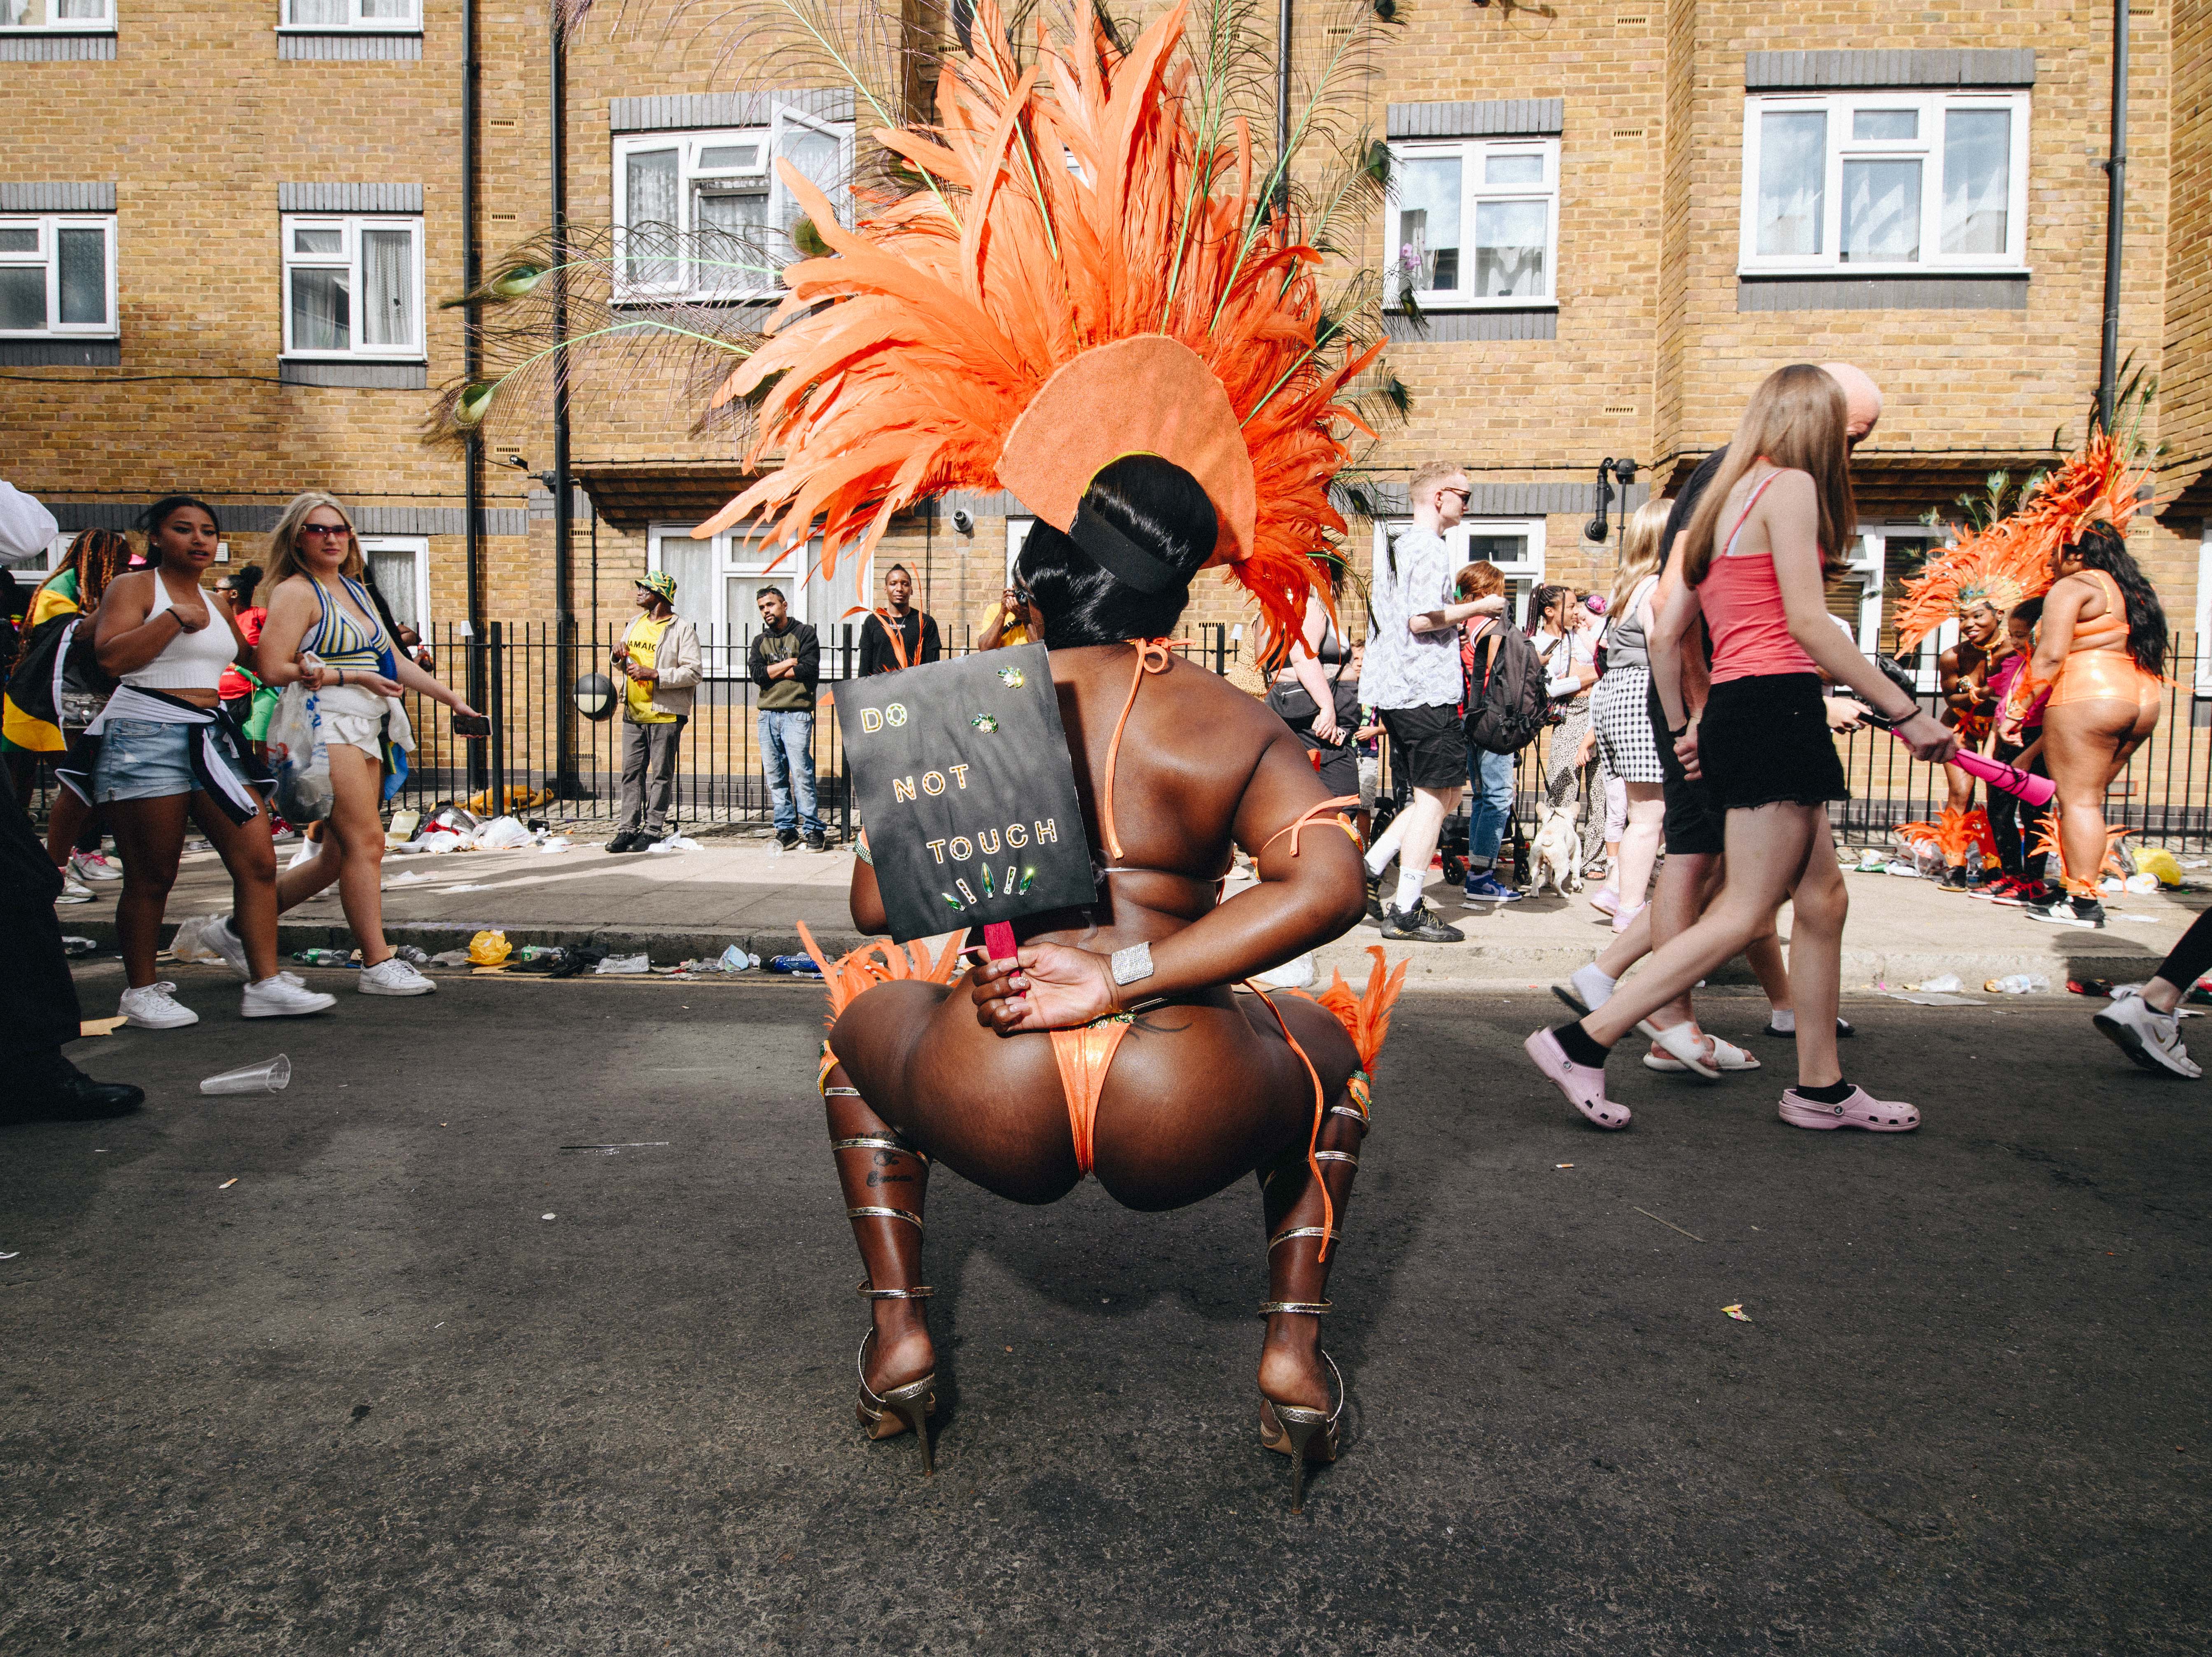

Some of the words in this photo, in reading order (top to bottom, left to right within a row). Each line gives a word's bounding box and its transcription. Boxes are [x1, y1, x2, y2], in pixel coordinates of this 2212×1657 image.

[860, 703, 907, 733] DO
[892, 764, 968, 803] NOT
[926, 818, 1058, 864] TOUCH
